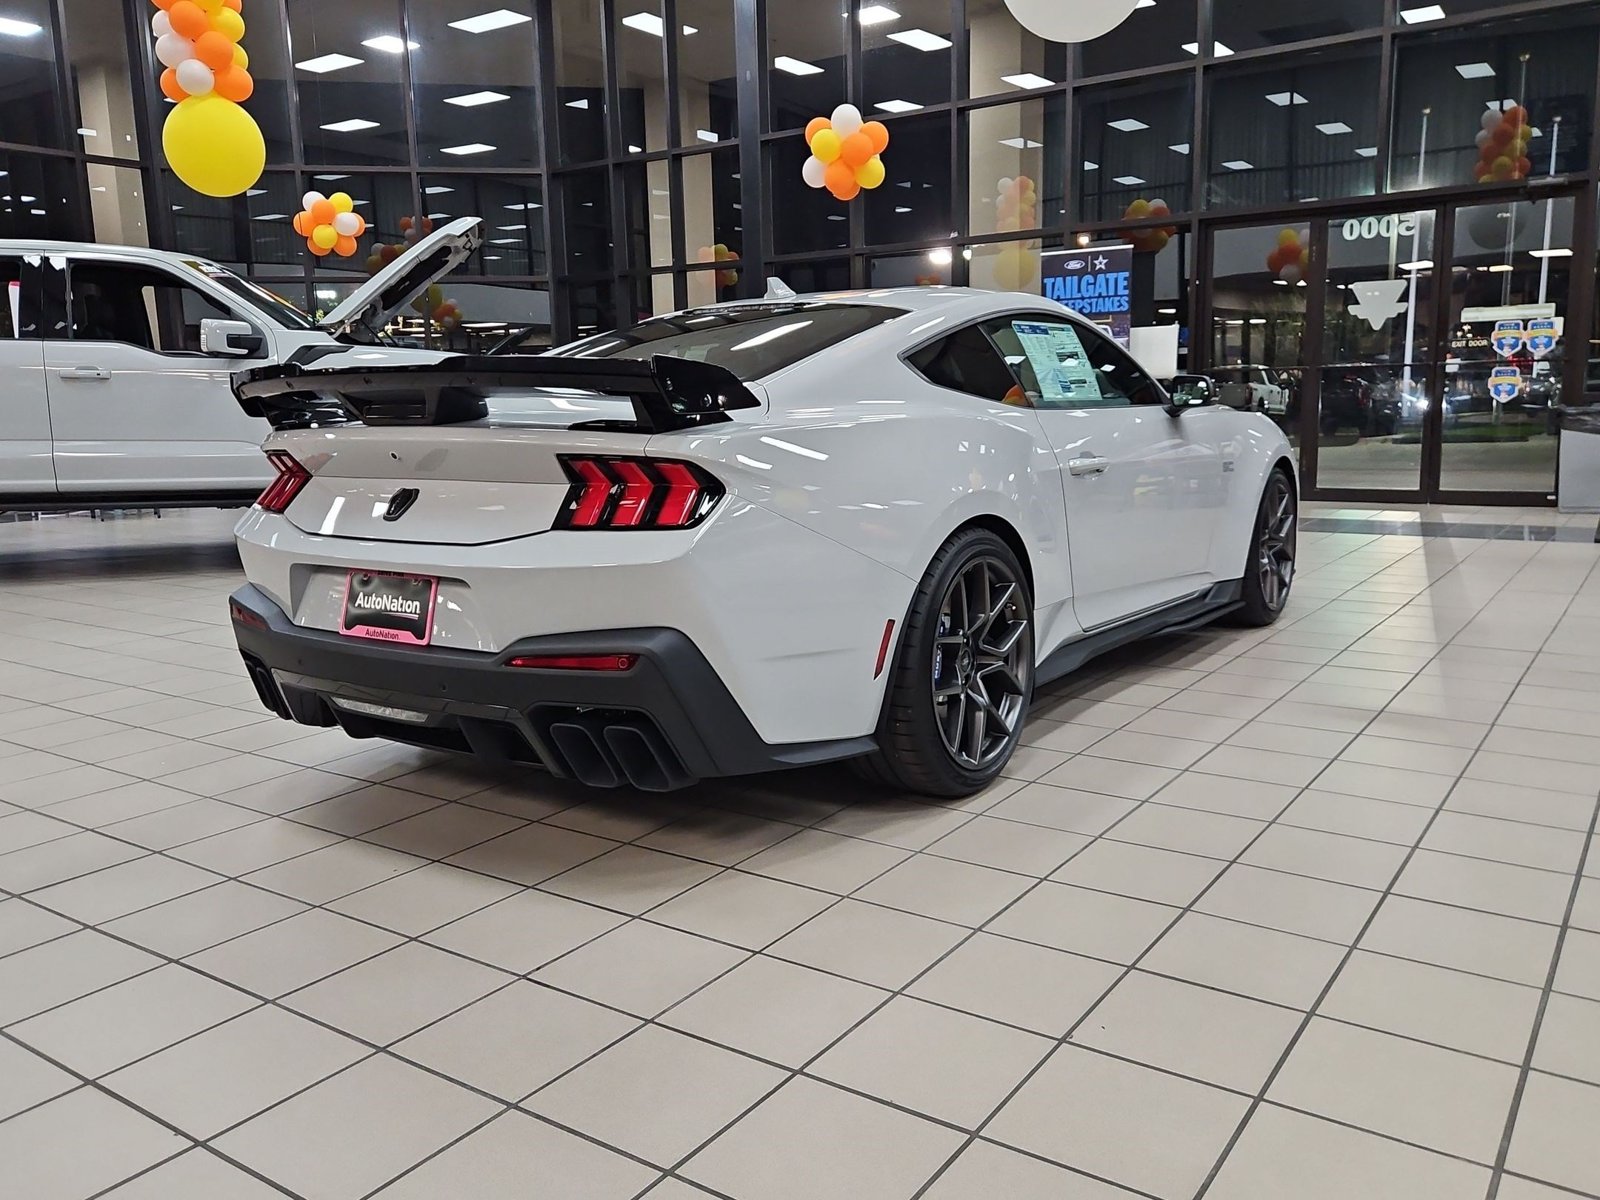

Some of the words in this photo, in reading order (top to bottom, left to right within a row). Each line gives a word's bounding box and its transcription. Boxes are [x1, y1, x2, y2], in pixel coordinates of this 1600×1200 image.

[1044, 272, 1129, 299] TAILGATE
[1468, 339, 1489, 347] DOOR
[354, 591, 421, 614] AutoNation
[364, 628, 400, 640] AutoNation
